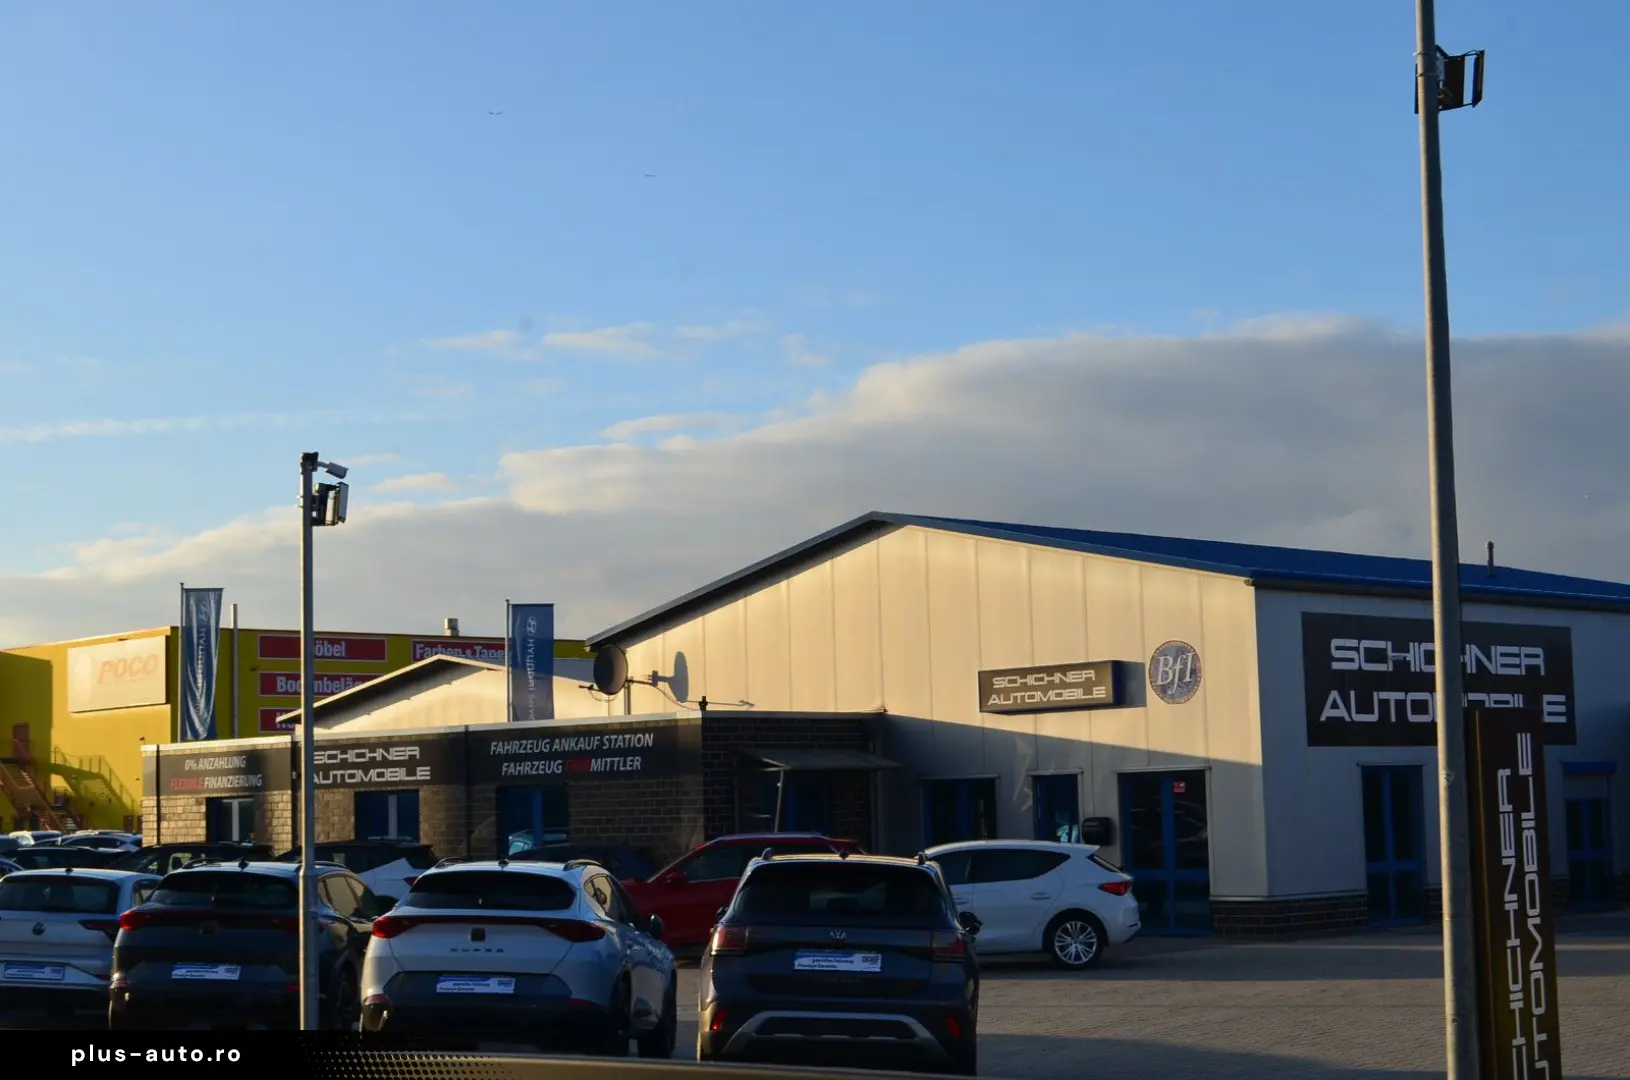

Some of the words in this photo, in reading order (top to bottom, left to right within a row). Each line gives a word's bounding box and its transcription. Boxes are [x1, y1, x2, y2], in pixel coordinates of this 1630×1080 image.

[314, 640, 346, 657] öbel
[98, 653, 159, 686] POCO
[992, 670, 1096, 688] SCHICHNER
[987, 686, 1106, 706] AUTOMOBILE
[490, 739, 550, 754] FAHRZEUG
[552, 736, 600, 752] ANKAUF
[602, 733, 654, 750] STATION
[198, 756, 247, 771] ANZAHLUNG
[502, 760, 563, 776] FAHRZEUG
